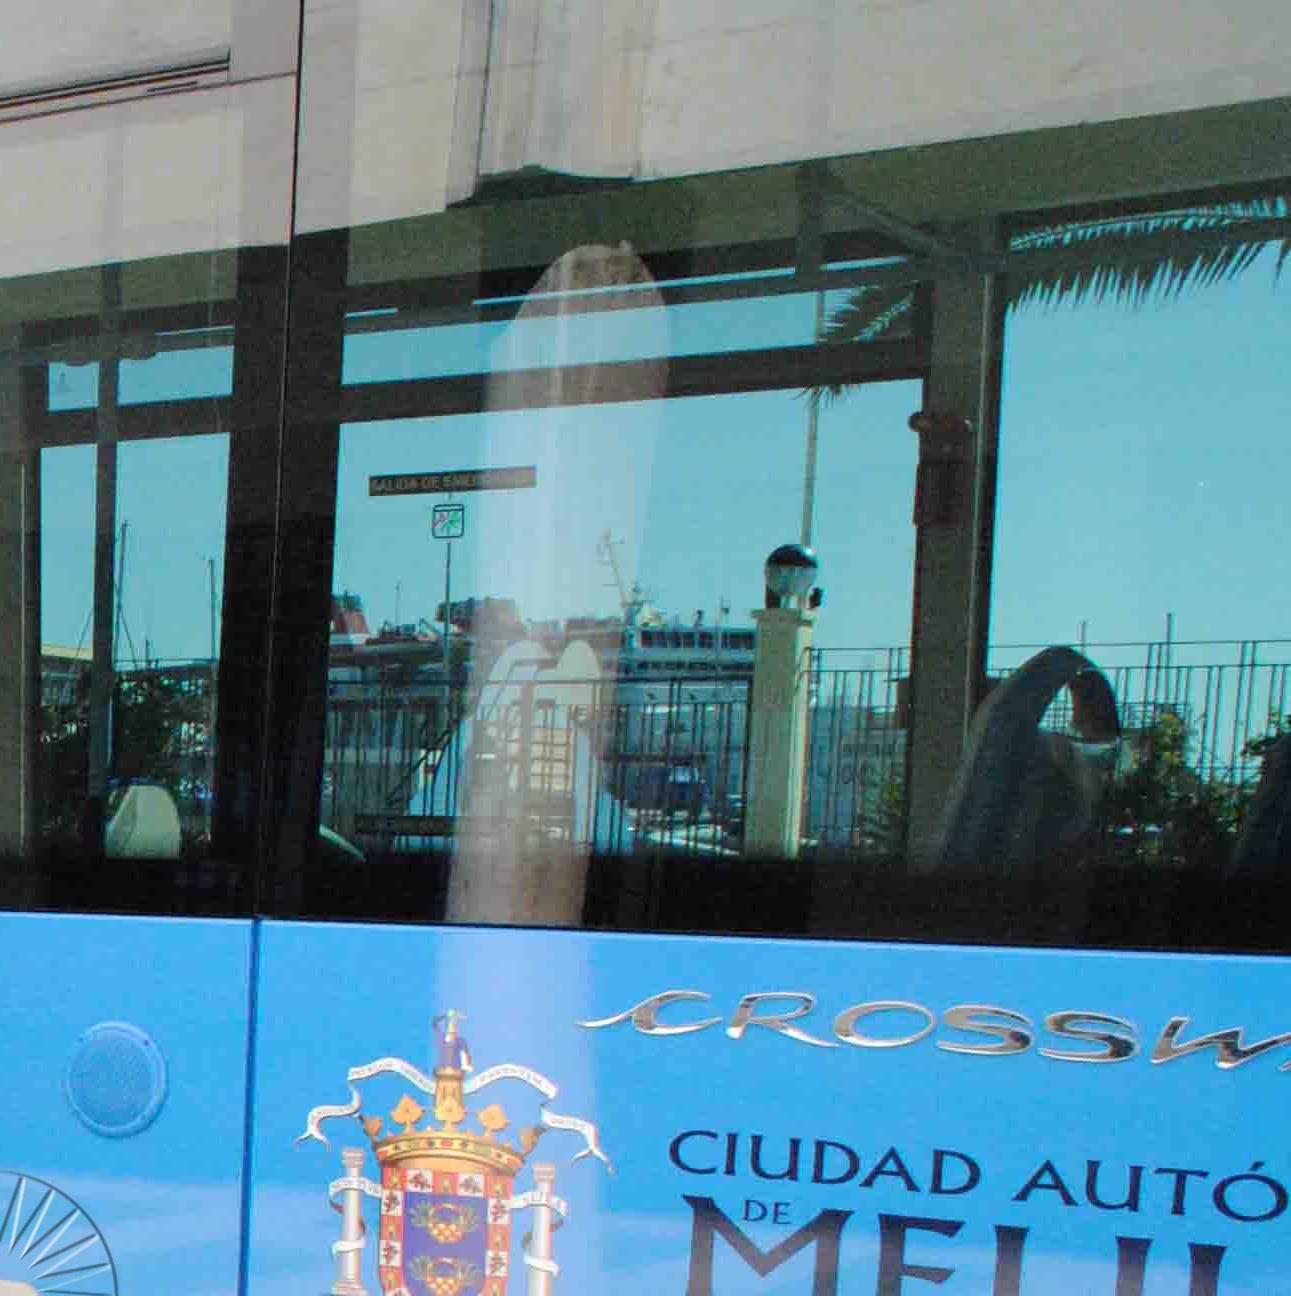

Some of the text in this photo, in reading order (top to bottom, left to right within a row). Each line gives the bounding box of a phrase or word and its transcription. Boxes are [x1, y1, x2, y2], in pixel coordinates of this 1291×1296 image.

[572, 988, 1291, 1072] CROSSW
[669, 1129, 1290, 1222] CIUDAD AUTÓ
[742, 1197, 793, 1226] DE
